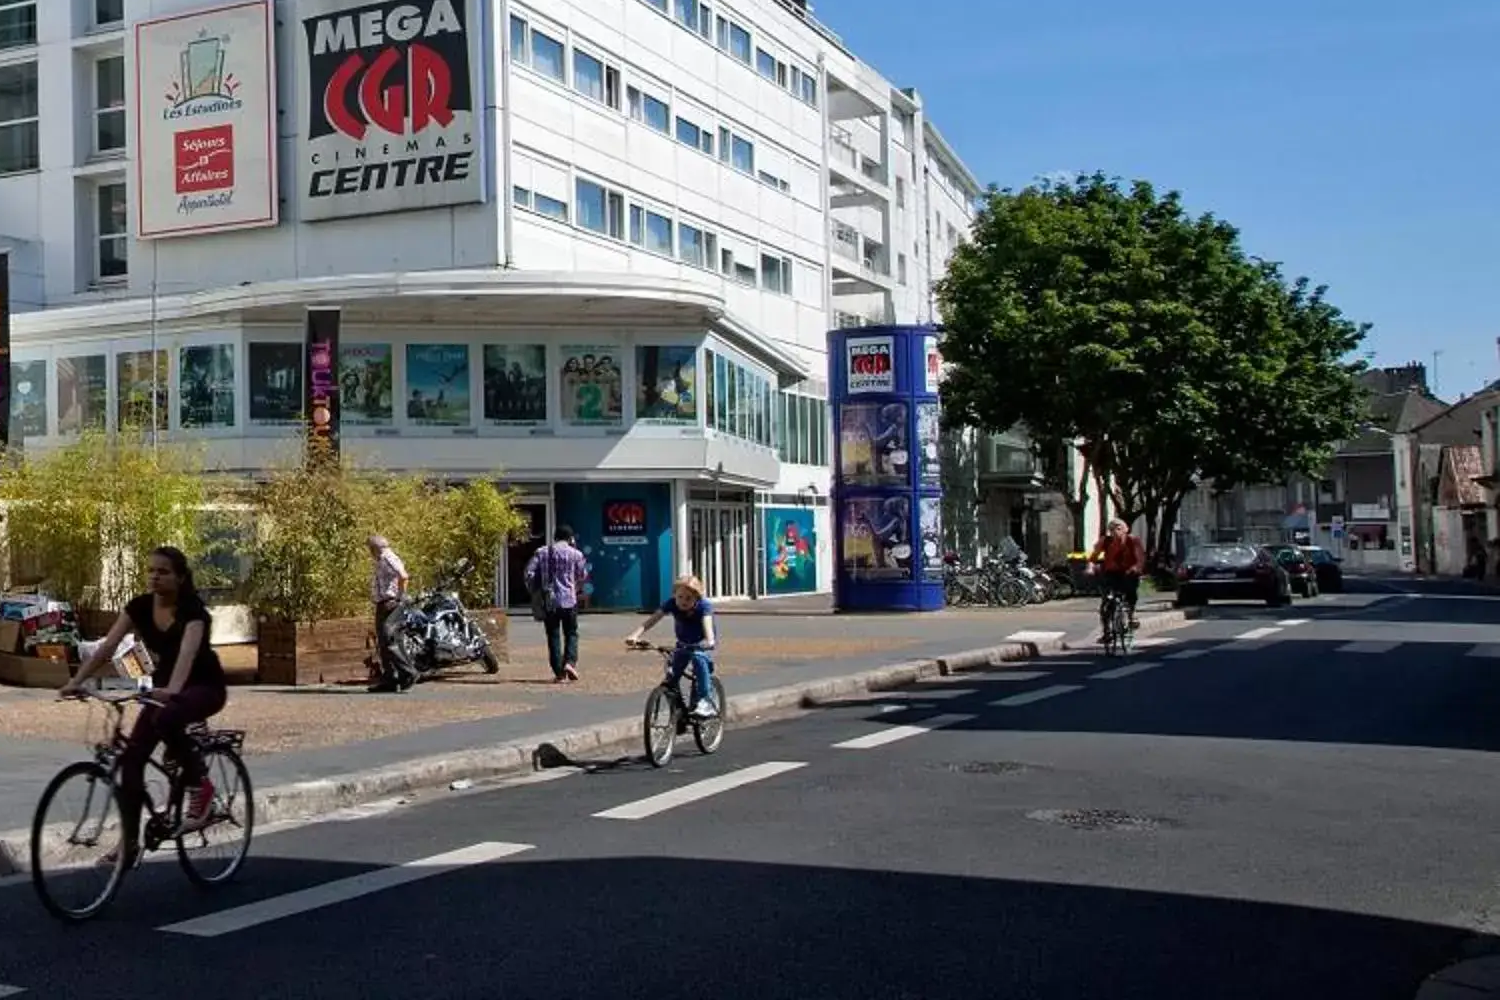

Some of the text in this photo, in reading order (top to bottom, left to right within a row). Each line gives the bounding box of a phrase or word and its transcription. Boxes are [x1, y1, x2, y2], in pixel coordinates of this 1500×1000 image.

[324, 44, 456, 140] CGR
[311, 133, 472, 165] CINEMAS
[181, 169, 229, 184] Affaires
[308, 150, 474, 198] CENTRE
